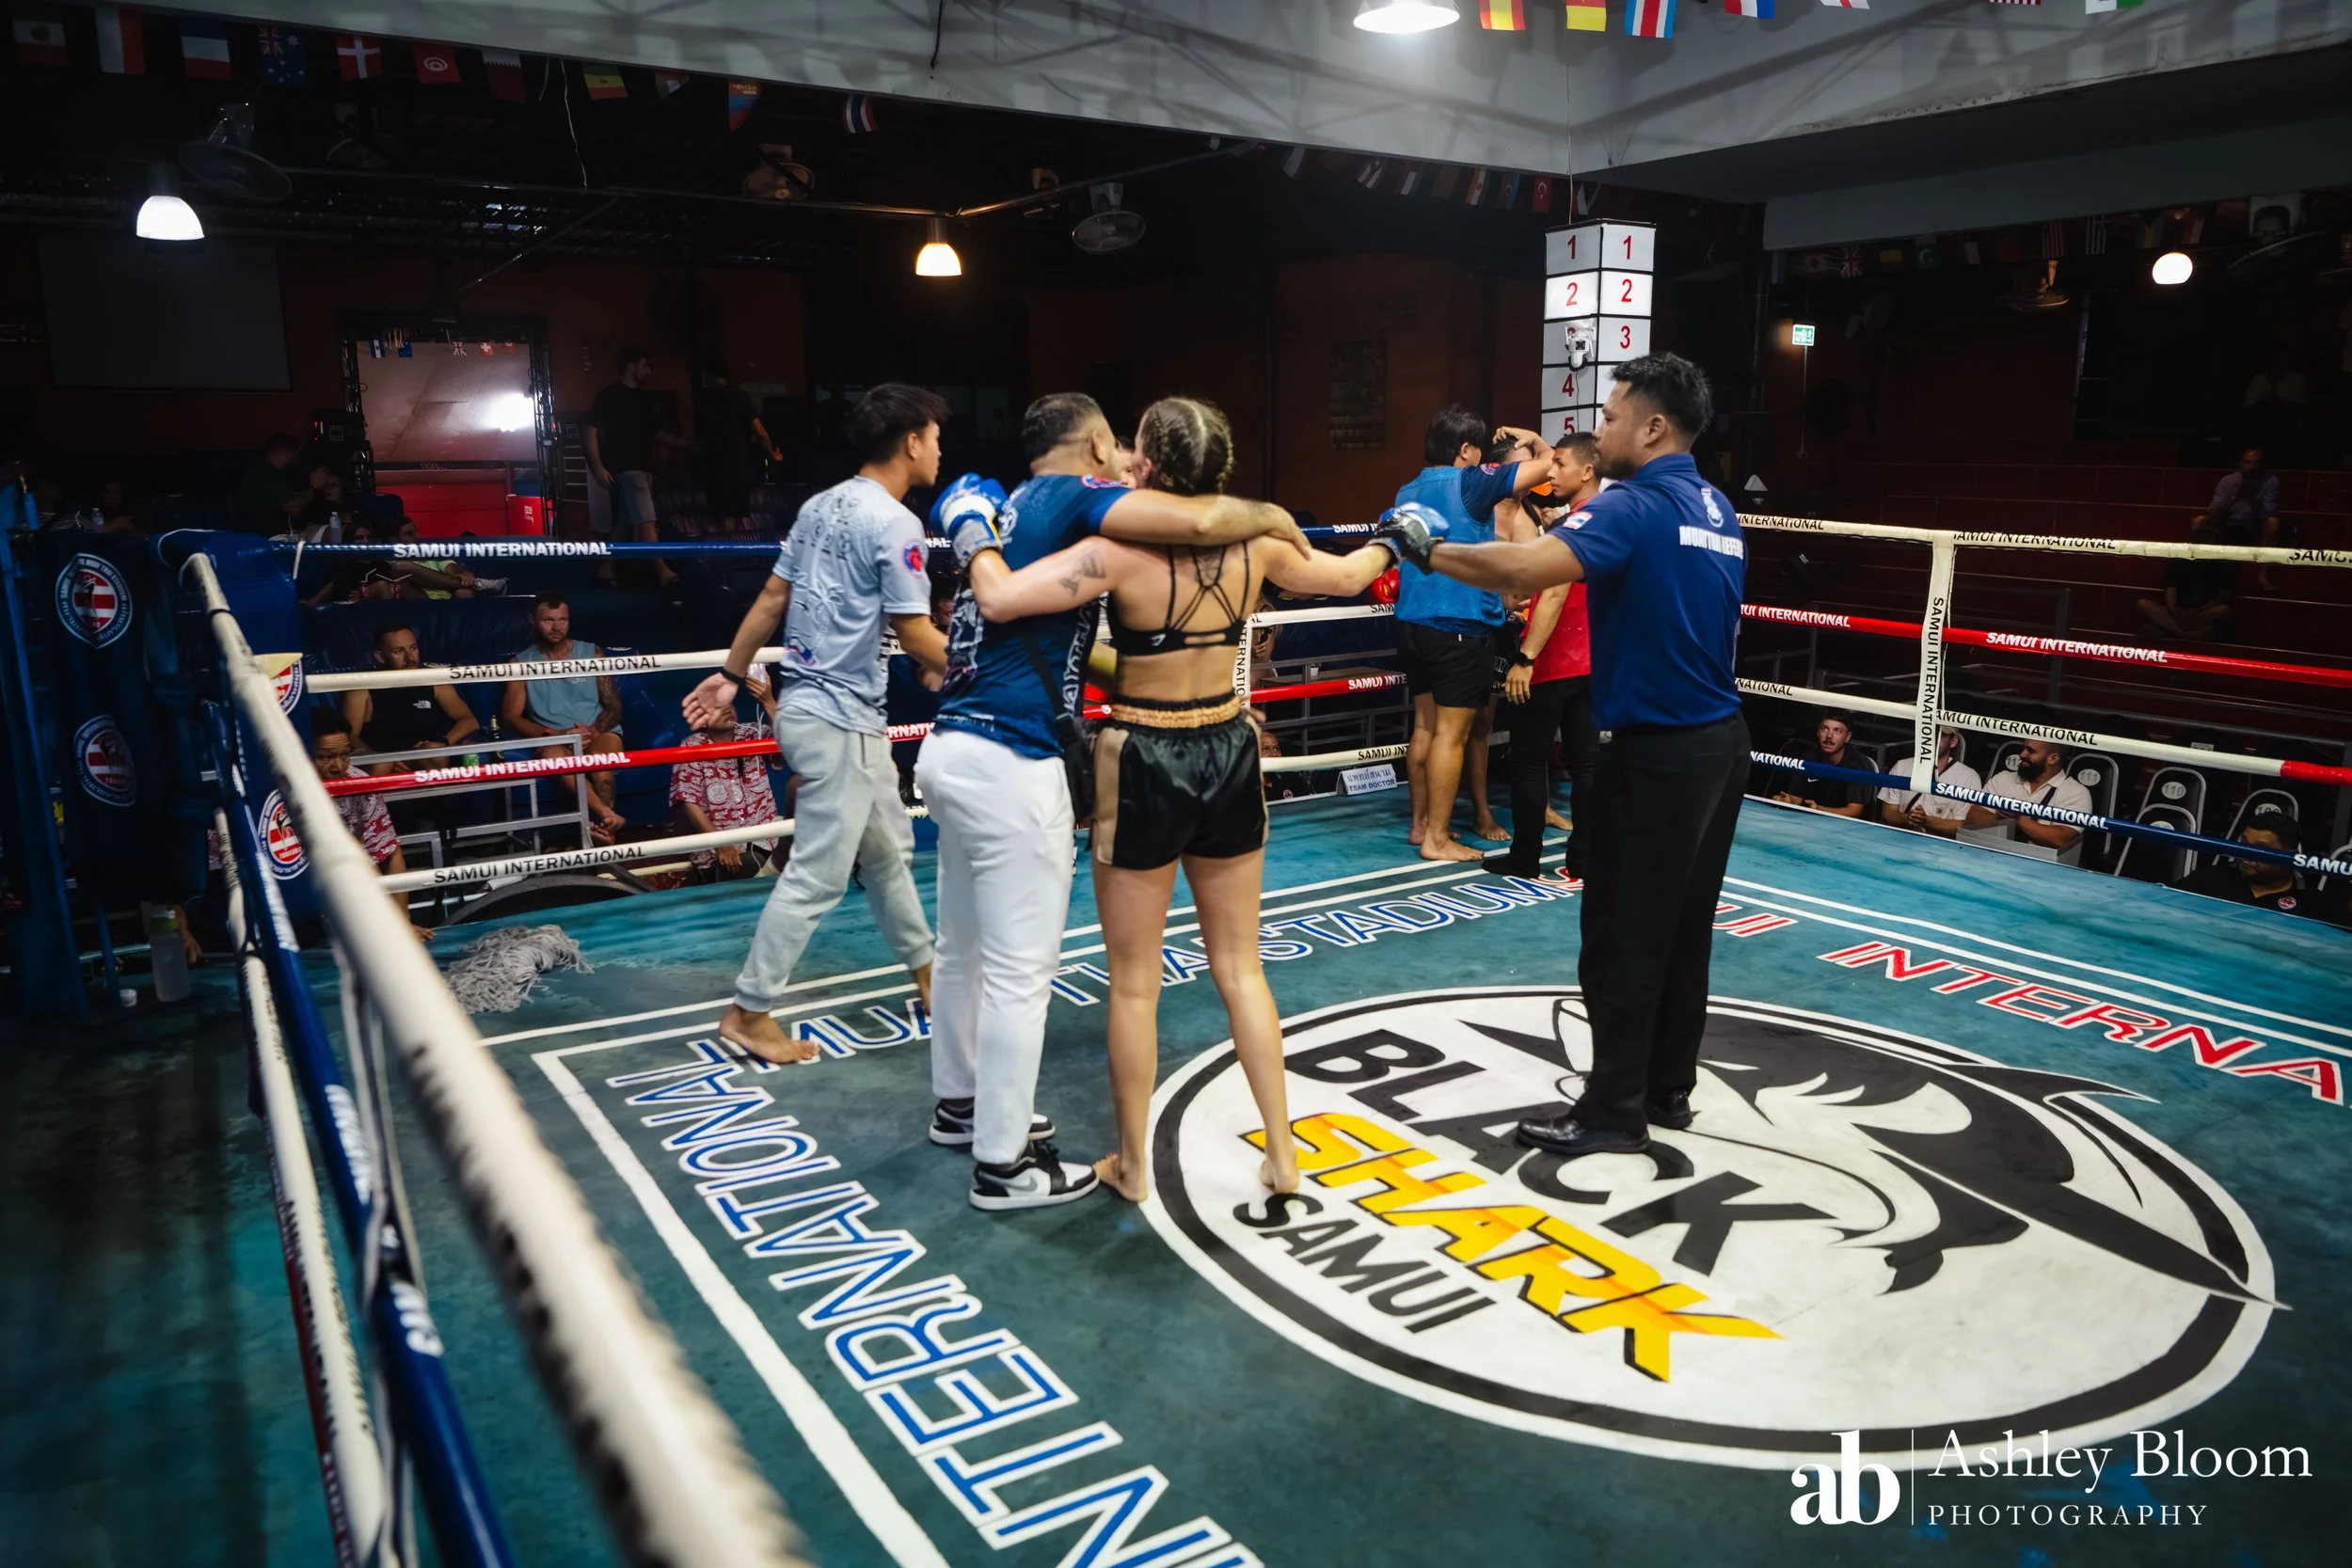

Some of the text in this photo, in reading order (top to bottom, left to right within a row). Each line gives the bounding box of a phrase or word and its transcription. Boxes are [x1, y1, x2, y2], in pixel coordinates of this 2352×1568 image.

[1567, 234, 1577, 260] 1
[1623, 234, 1632, 260] 1
[1565, 282, 1578, 307] 2
[1621, 278, 1633, 303] 2
[1619, 325, 1630, 349] 3
[1562, 373, 1574, 397] 4
[1332, 523, 1369, 533] SAMUI
[393, 541, 612, 558] SAMUI INTERNATIONAL
[1371, 603, 1394, 613] SAM
[1758, 606, 1851, 628] INTERNATIONAL
[1986, 632, 2169, 664] SAMUI INTERNATIONAL
[449, 655, 662, 680] SAMUI INTERNATIONAL
[1348, 677, 1383, 690] SAMUI
[1919, 596, 1945, 765] SAMUI INTERNATIONAL
[1935, 709, 2099, 746] AMUI INTERNATIONAL
[1358, 746, 1392, 760] SAMUI
[415, 752, 630, 783] SAMUI INTERNATIONAL
[1349, 779, 1395, 792] TEAM DOCTOR
[1936, 783, 2109, 831] SAMUI INTERNATIONAL
[435, 847, 647, 883] SAMUI INTERNATIONAL
[2293, 853, 2352, 877] SAMU
[1257, 875, 1558, 961] STADIUM
[1817, 941, 2344, 1106] INTERNA
[1237, 1112, 1787, 1384] SHARK
[1232, 1193, 1498, 1335] SAMUI
